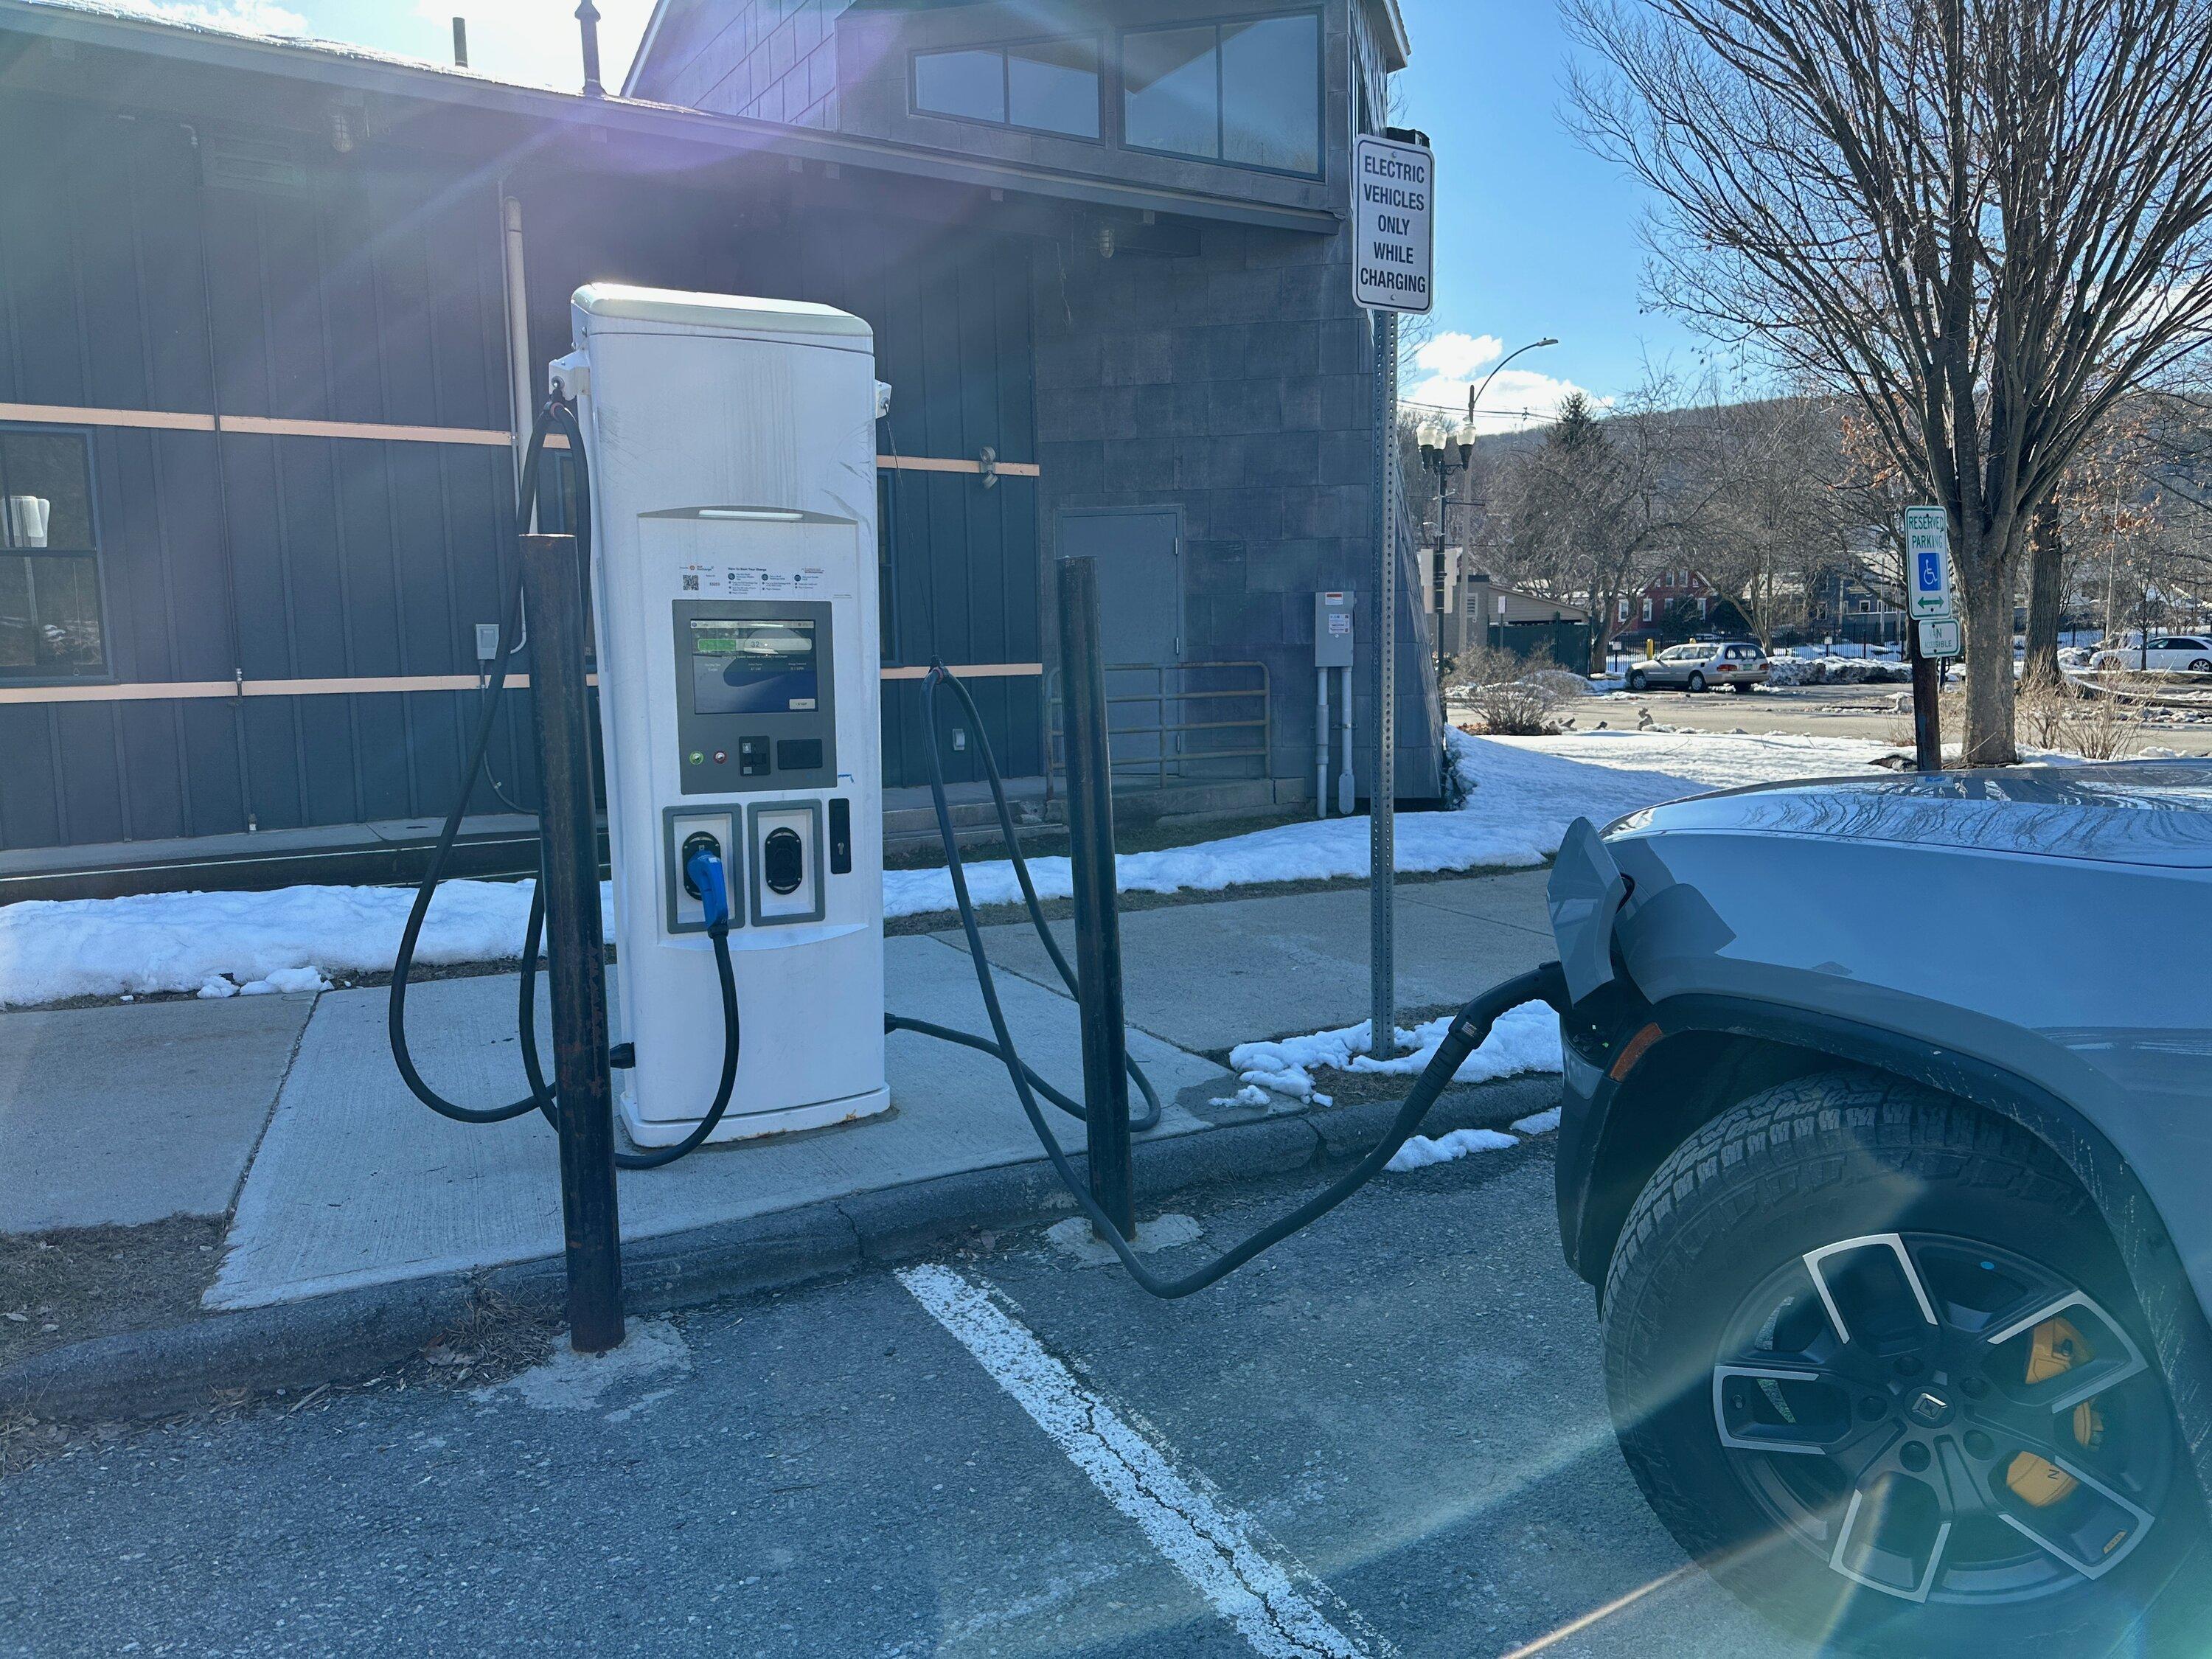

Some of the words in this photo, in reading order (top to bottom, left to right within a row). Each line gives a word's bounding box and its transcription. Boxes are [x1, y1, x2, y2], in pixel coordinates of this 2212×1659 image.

[1364, 156, 1425, 184] ELECTRIC
[1363, 183, 1425, 212] VEHICLES
[1377, 214, 1411, 236] ONLY
[1373, 241, 1413, 265] WHILE
[1360, 267, 1426, 293] CHARGING
[1908, 516, 1944, 530] RESERVED
[1912, 535, 1943, 549] PARKING
